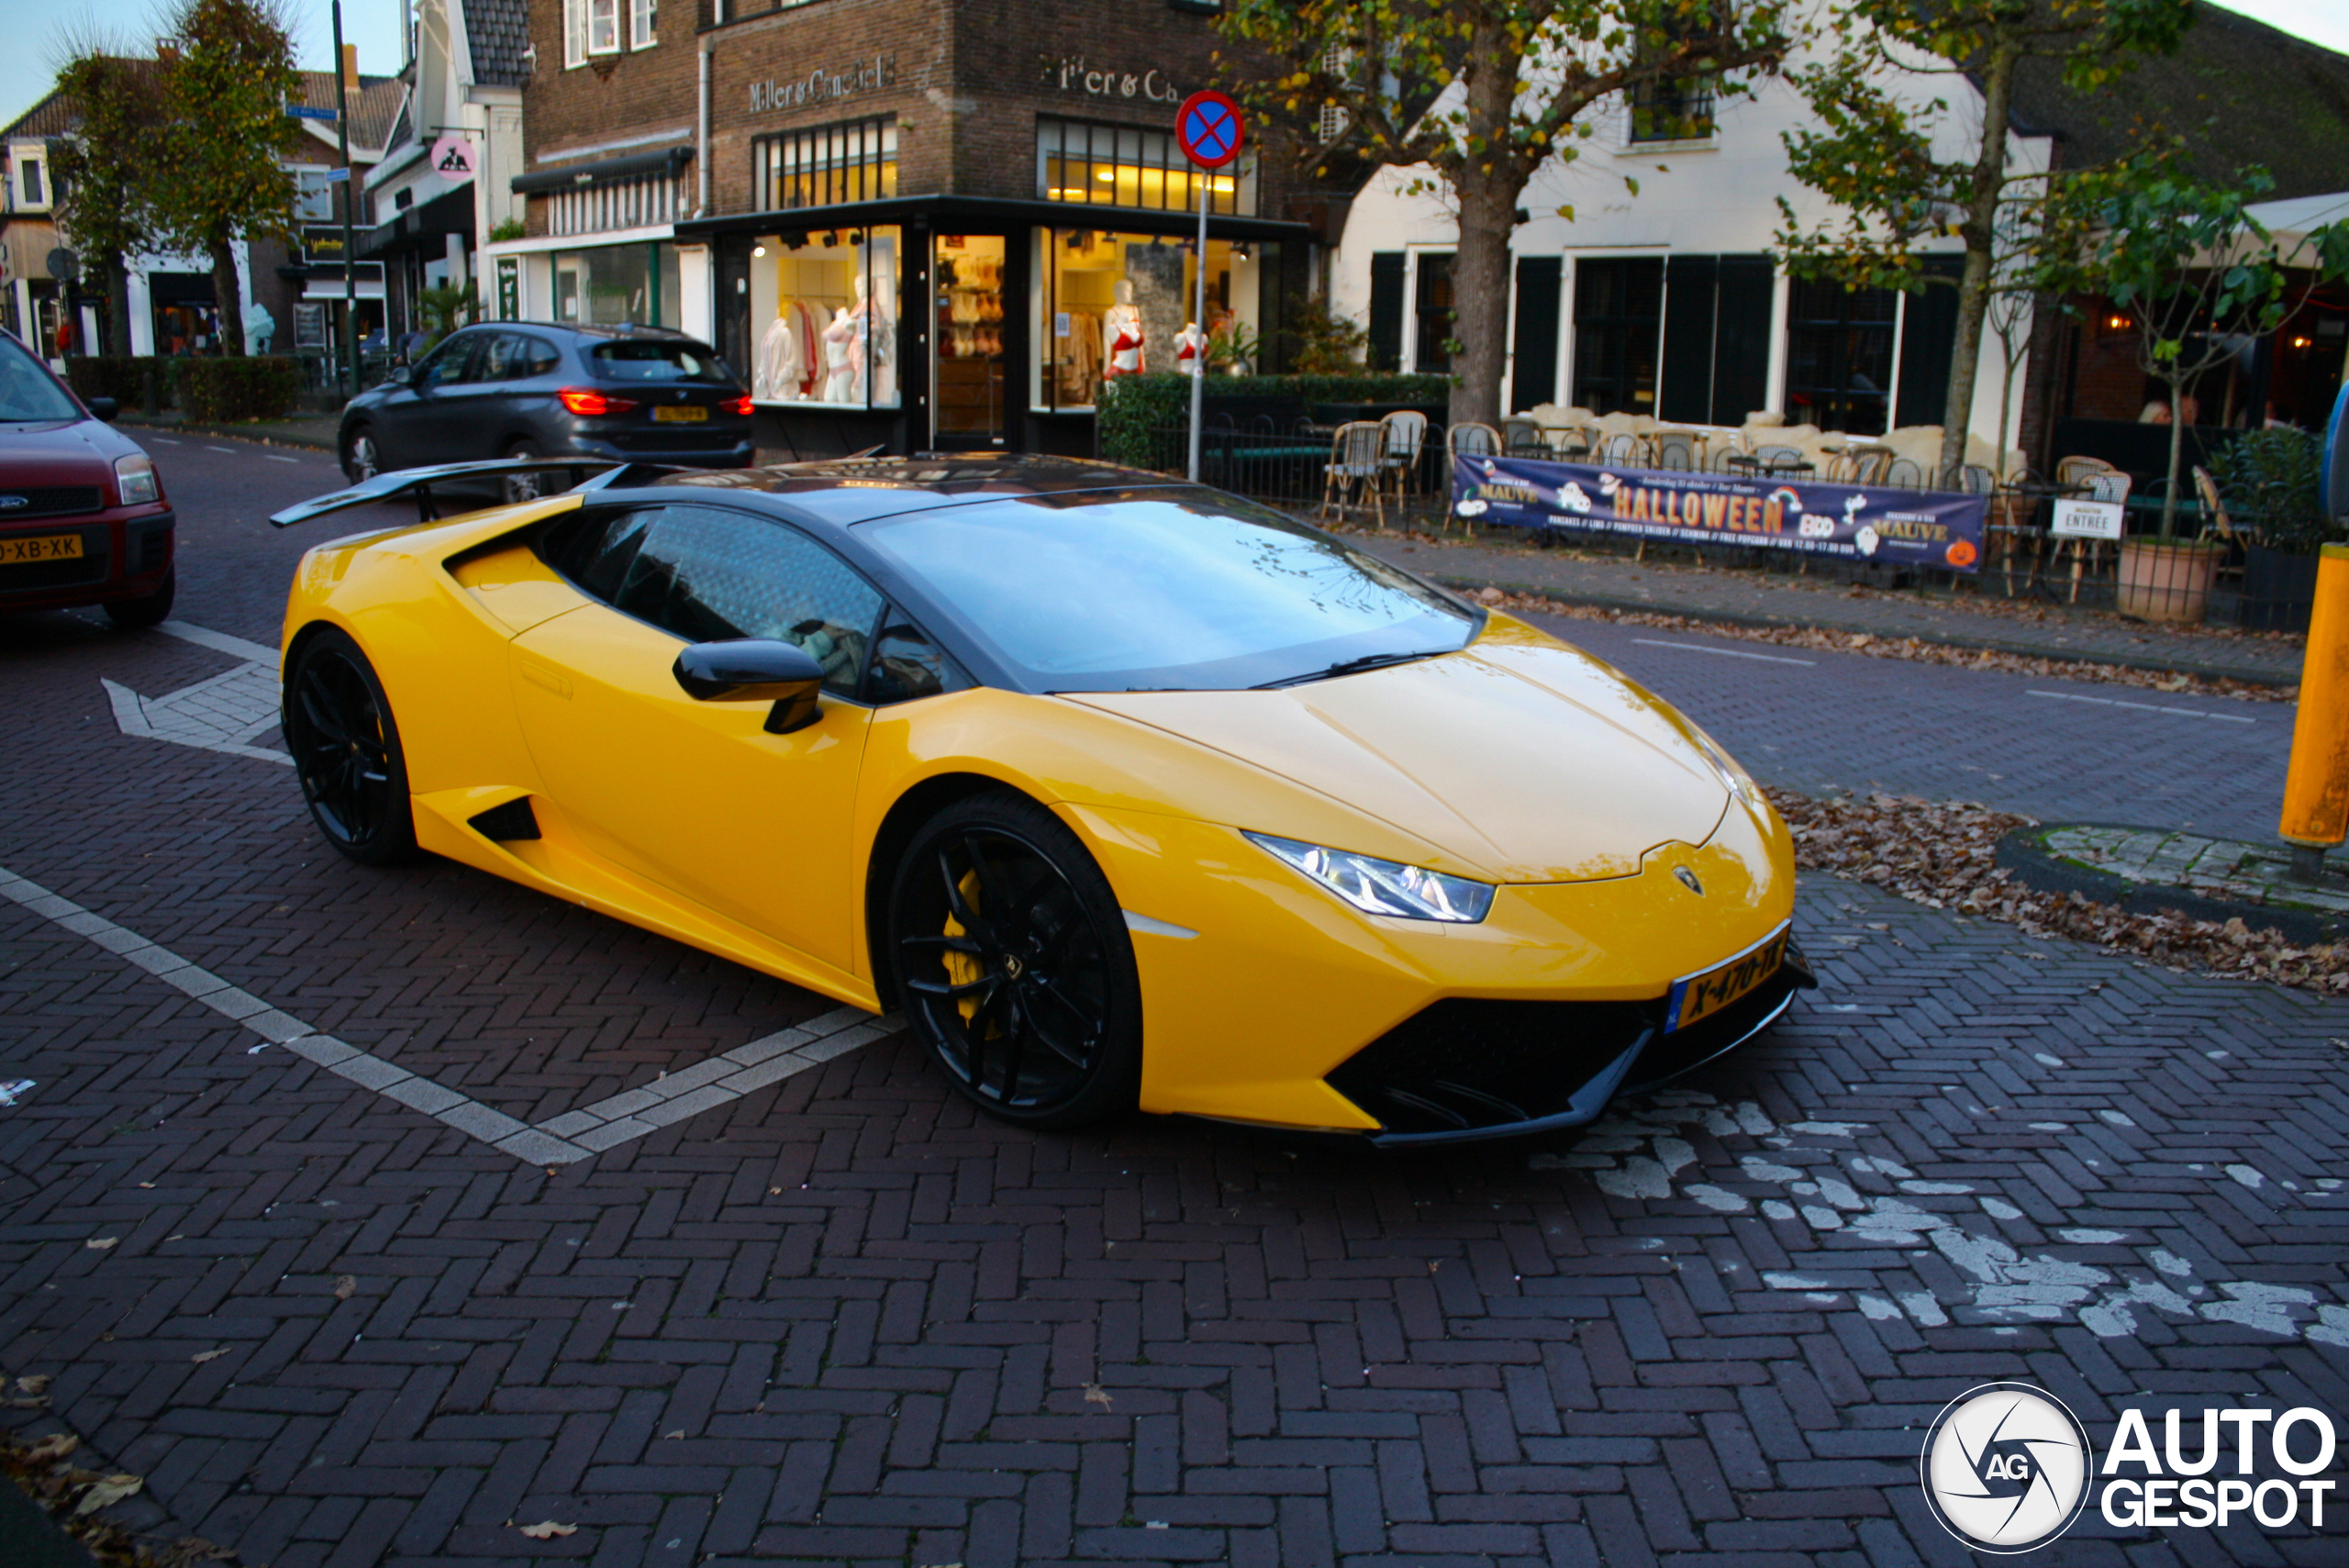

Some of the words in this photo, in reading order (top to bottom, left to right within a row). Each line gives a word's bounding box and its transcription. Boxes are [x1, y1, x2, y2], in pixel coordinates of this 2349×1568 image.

[1120, 73, 1138, 98] &
[1478, 484, 1539, 503] MAUVE
[1687, 479, 1711, 490] oktober
[1614, 486, 1784, 534] HALLOWEEN
[1548, 515, 1580, 527] PANCAKES
[1720, 531, 1736, 542] FREE
[1737, 533, 1769, 546] POPCORN
[1777, 538, 1793, 548] VAN
[1873, 518, 1948, 541] MAUVE
